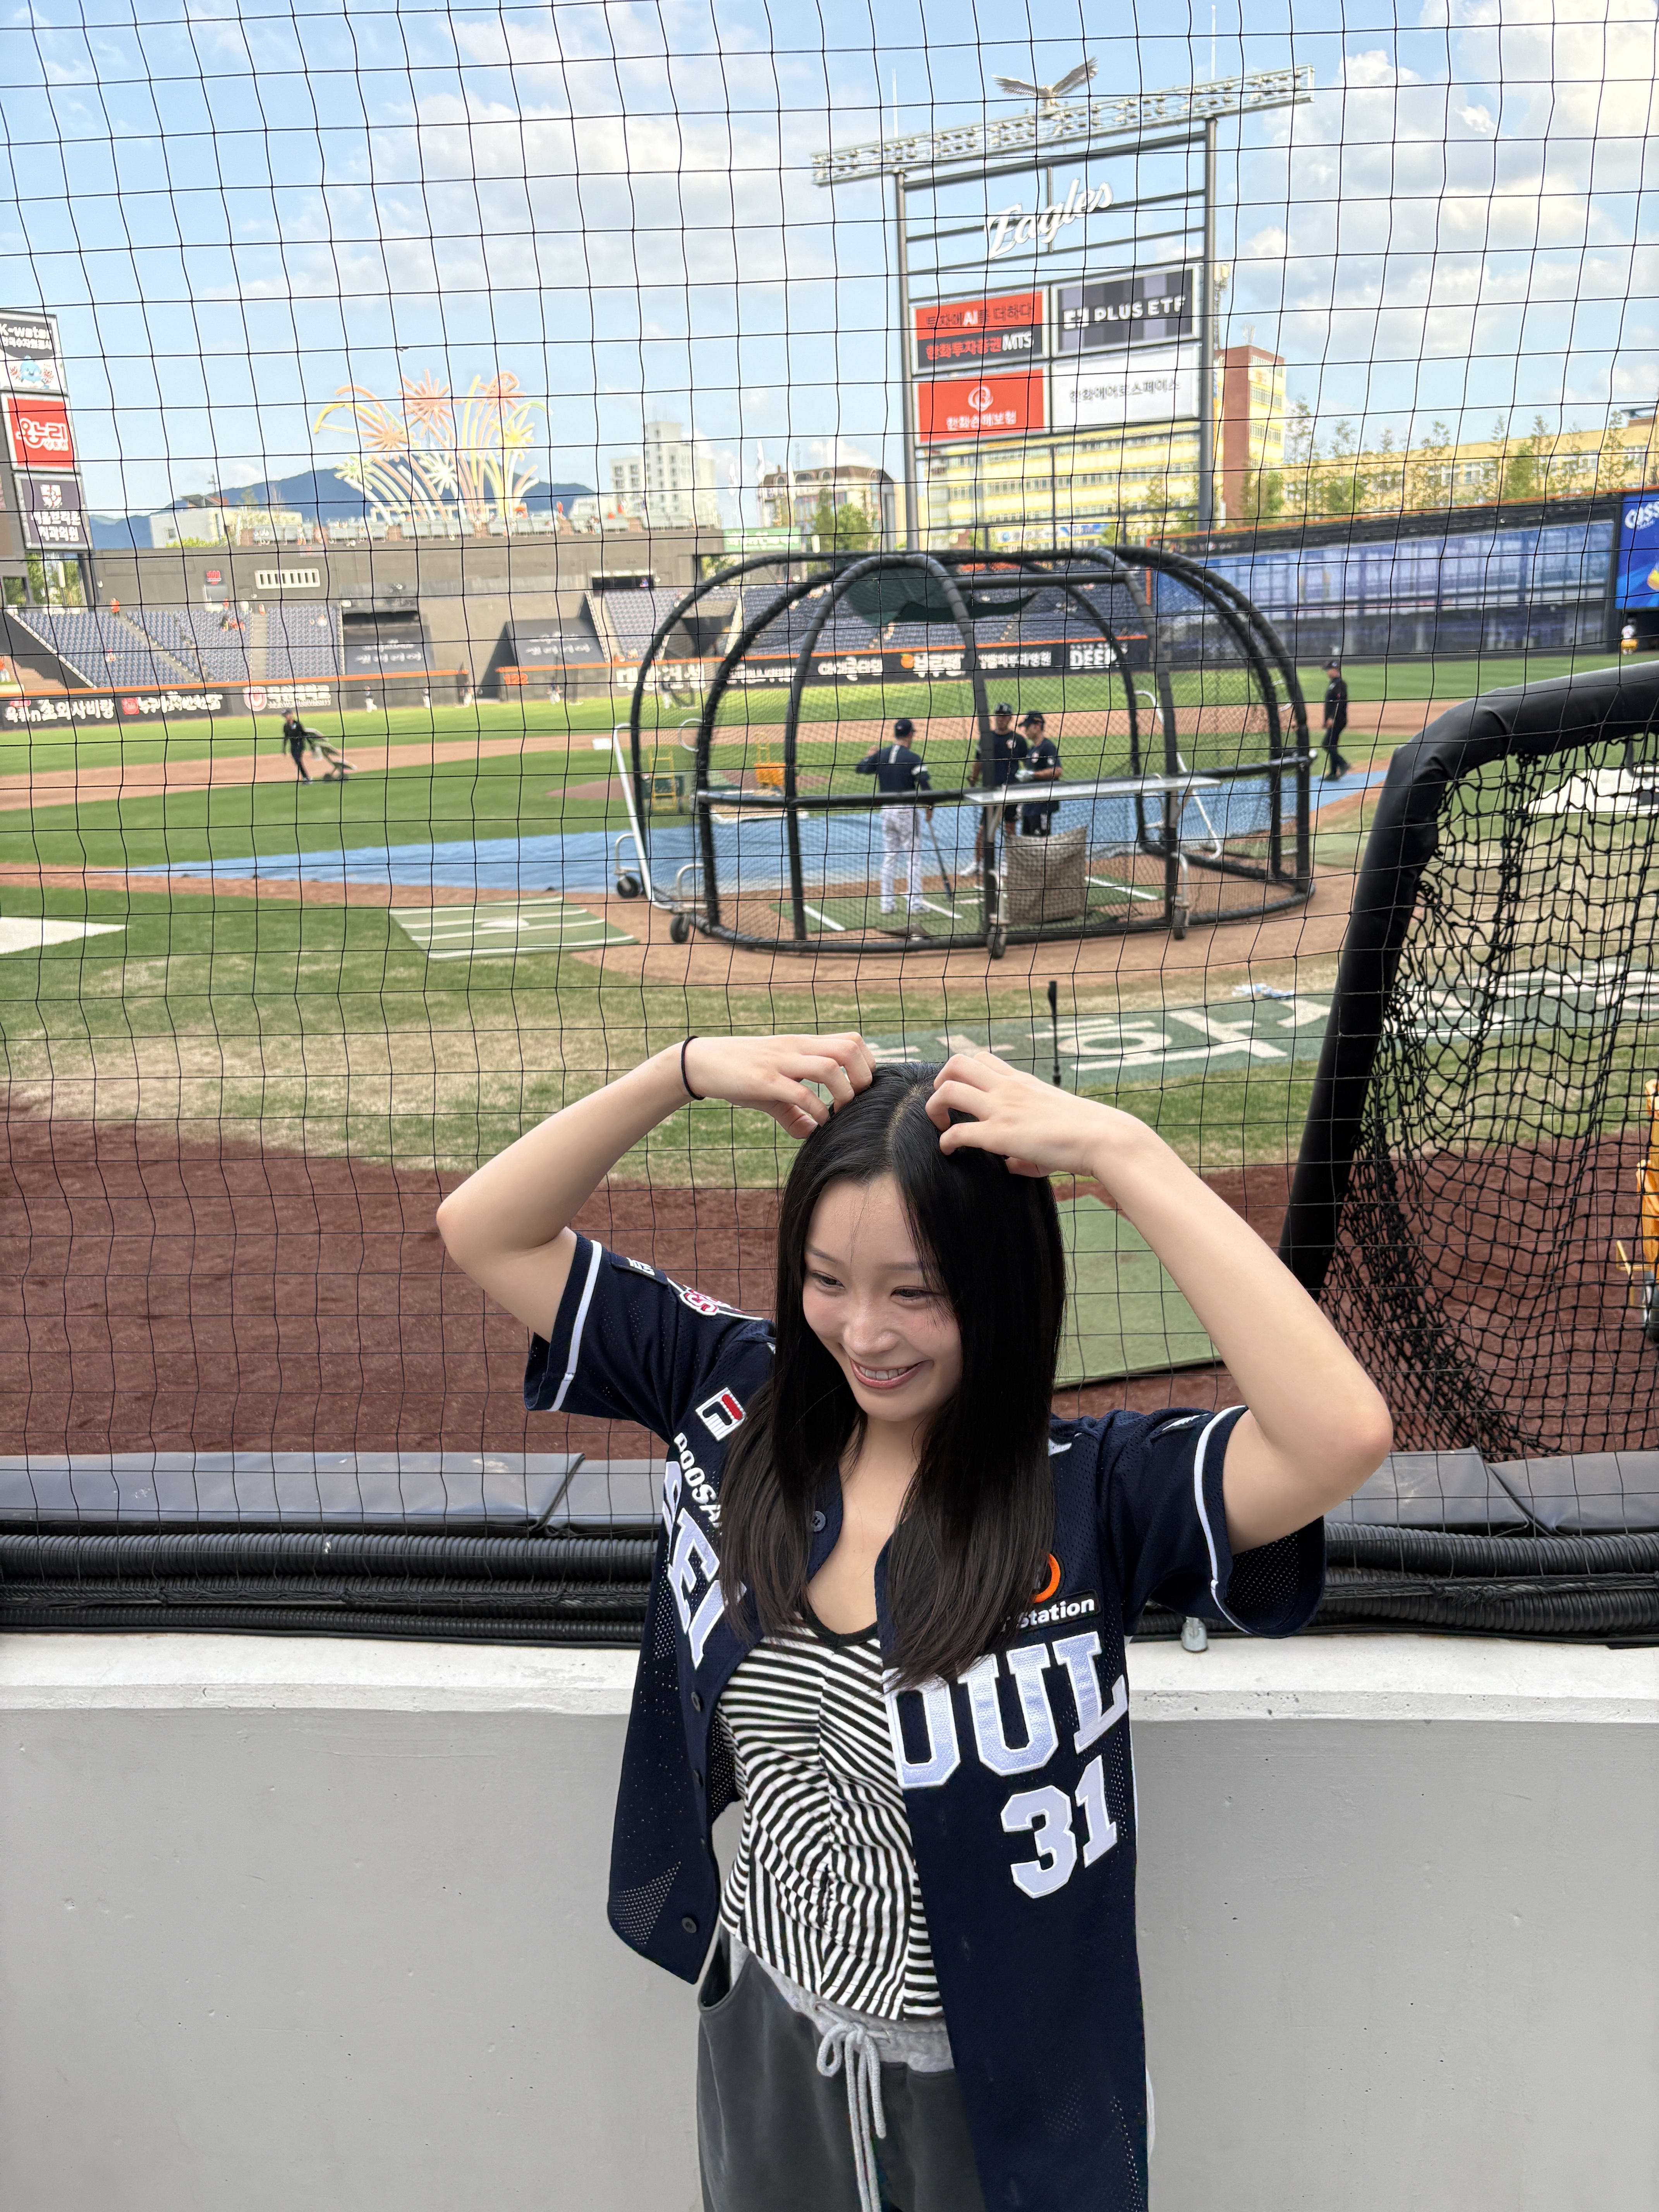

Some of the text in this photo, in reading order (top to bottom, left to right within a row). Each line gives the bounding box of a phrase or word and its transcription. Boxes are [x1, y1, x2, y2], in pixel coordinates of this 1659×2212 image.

[984, 178, 1113, 261] Eagles
[1094, 295, 1186, 323] PLUS ETF
[0, 323, 52, 340] K-water
[926, 331, 1034, 361] 한화투자증권MTS
[1070, 377, 1181, 403] 한화에어로스페이스
[946, 410, 1016, 430] 한화손해보험
[38, 526, 79, 542] 치과의원
[673, 1432, 721, 1529] DOOSA
[1001, 1756, 1118, 1899] 31
